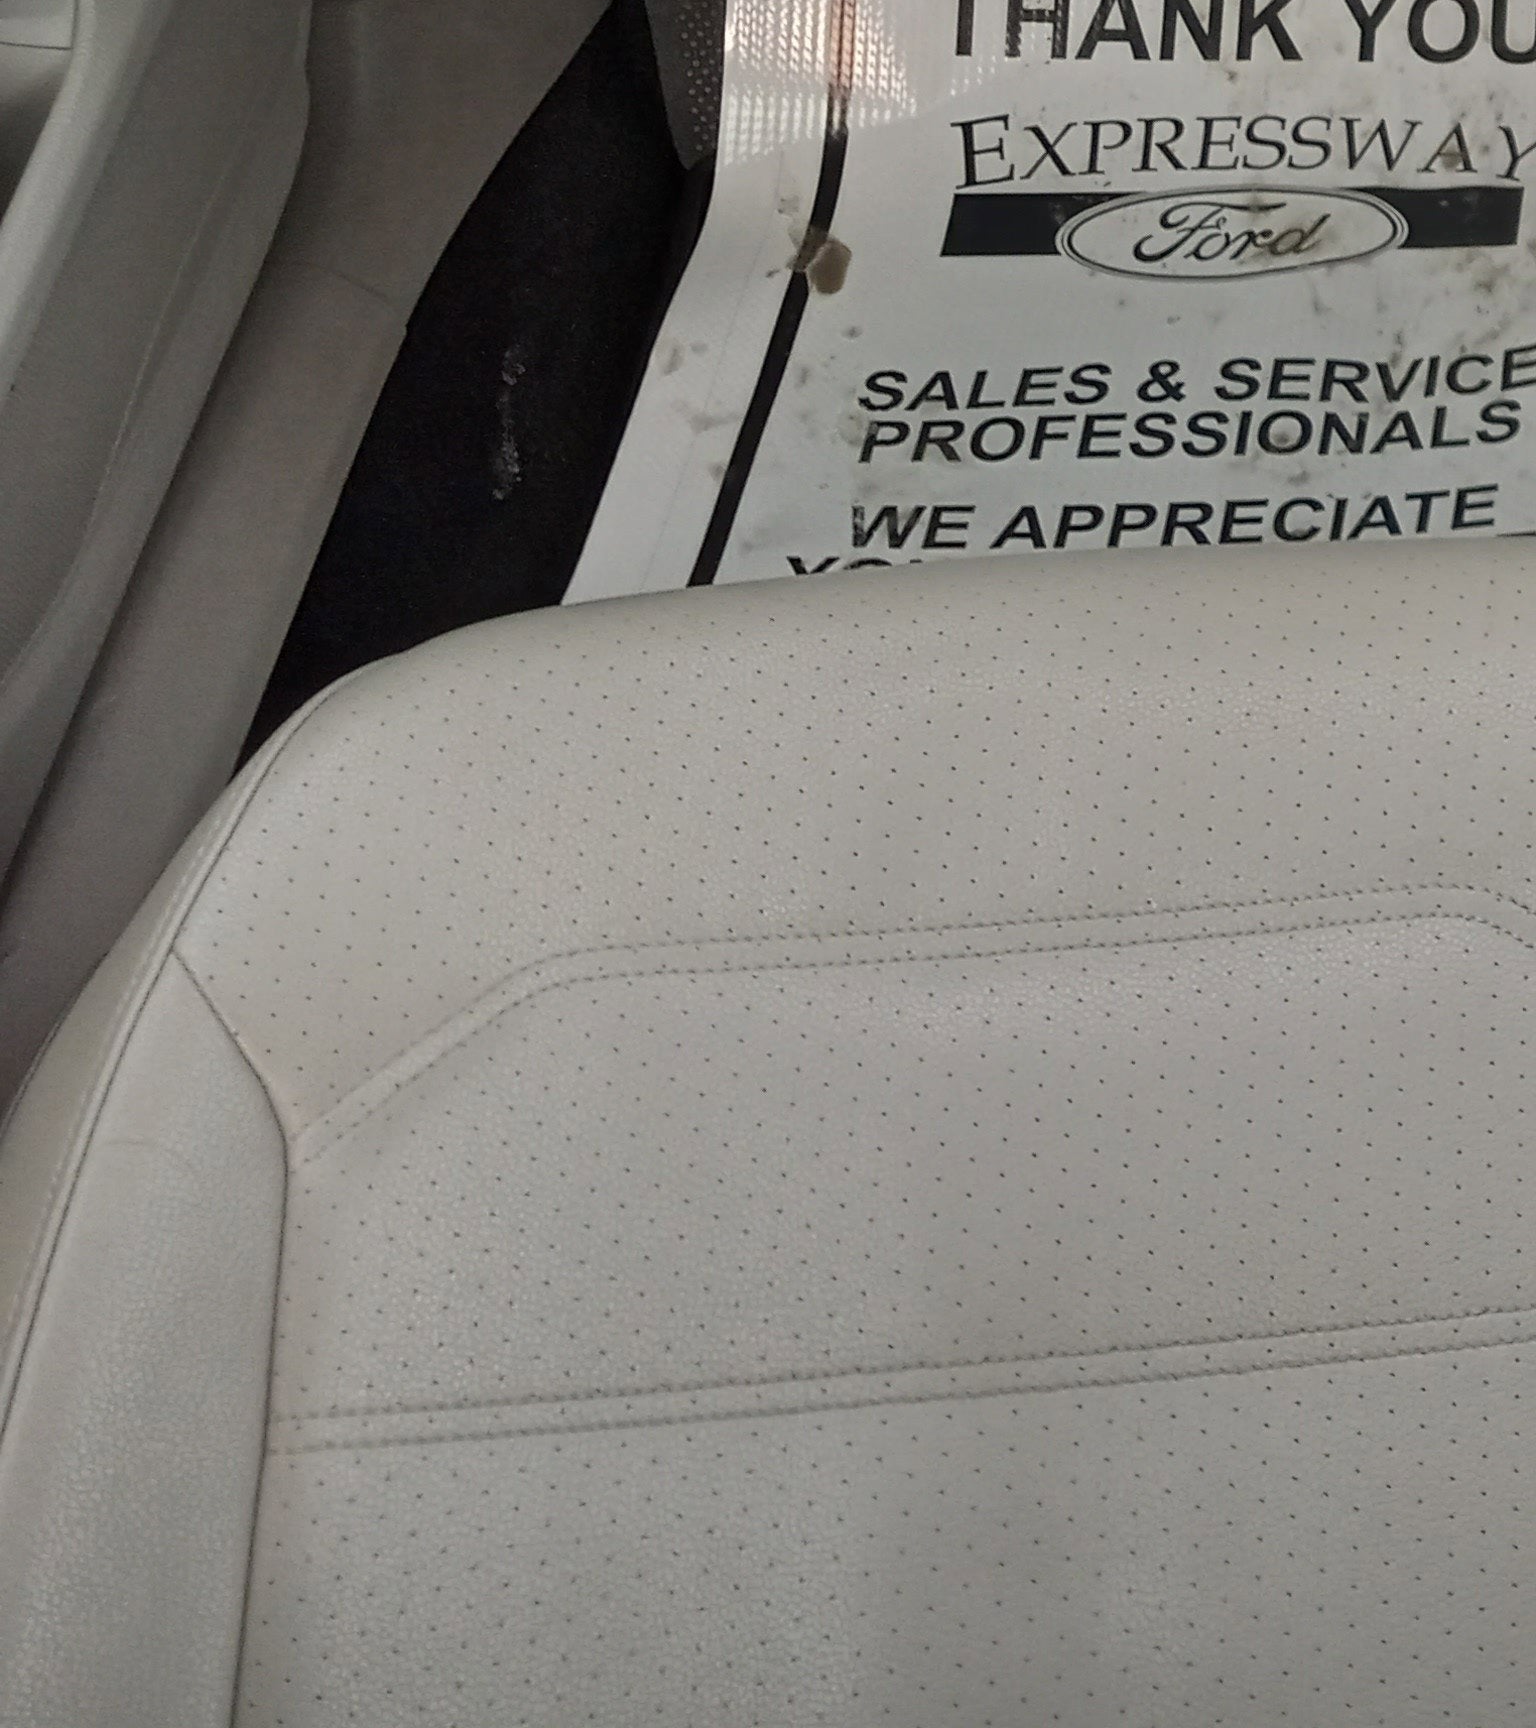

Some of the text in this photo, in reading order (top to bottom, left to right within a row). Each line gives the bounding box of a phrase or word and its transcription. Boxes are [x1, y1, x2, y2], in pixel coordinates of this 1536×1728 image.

[1132, 200, 1331, 262] Ford
[858, 362, 1112, 411] SALES
[1136, 359, 1187, 402] &
[858, 399, 1522, 464] PROFESSIONALS
[851, 484, 1499, 550] WE APPRECIATE
